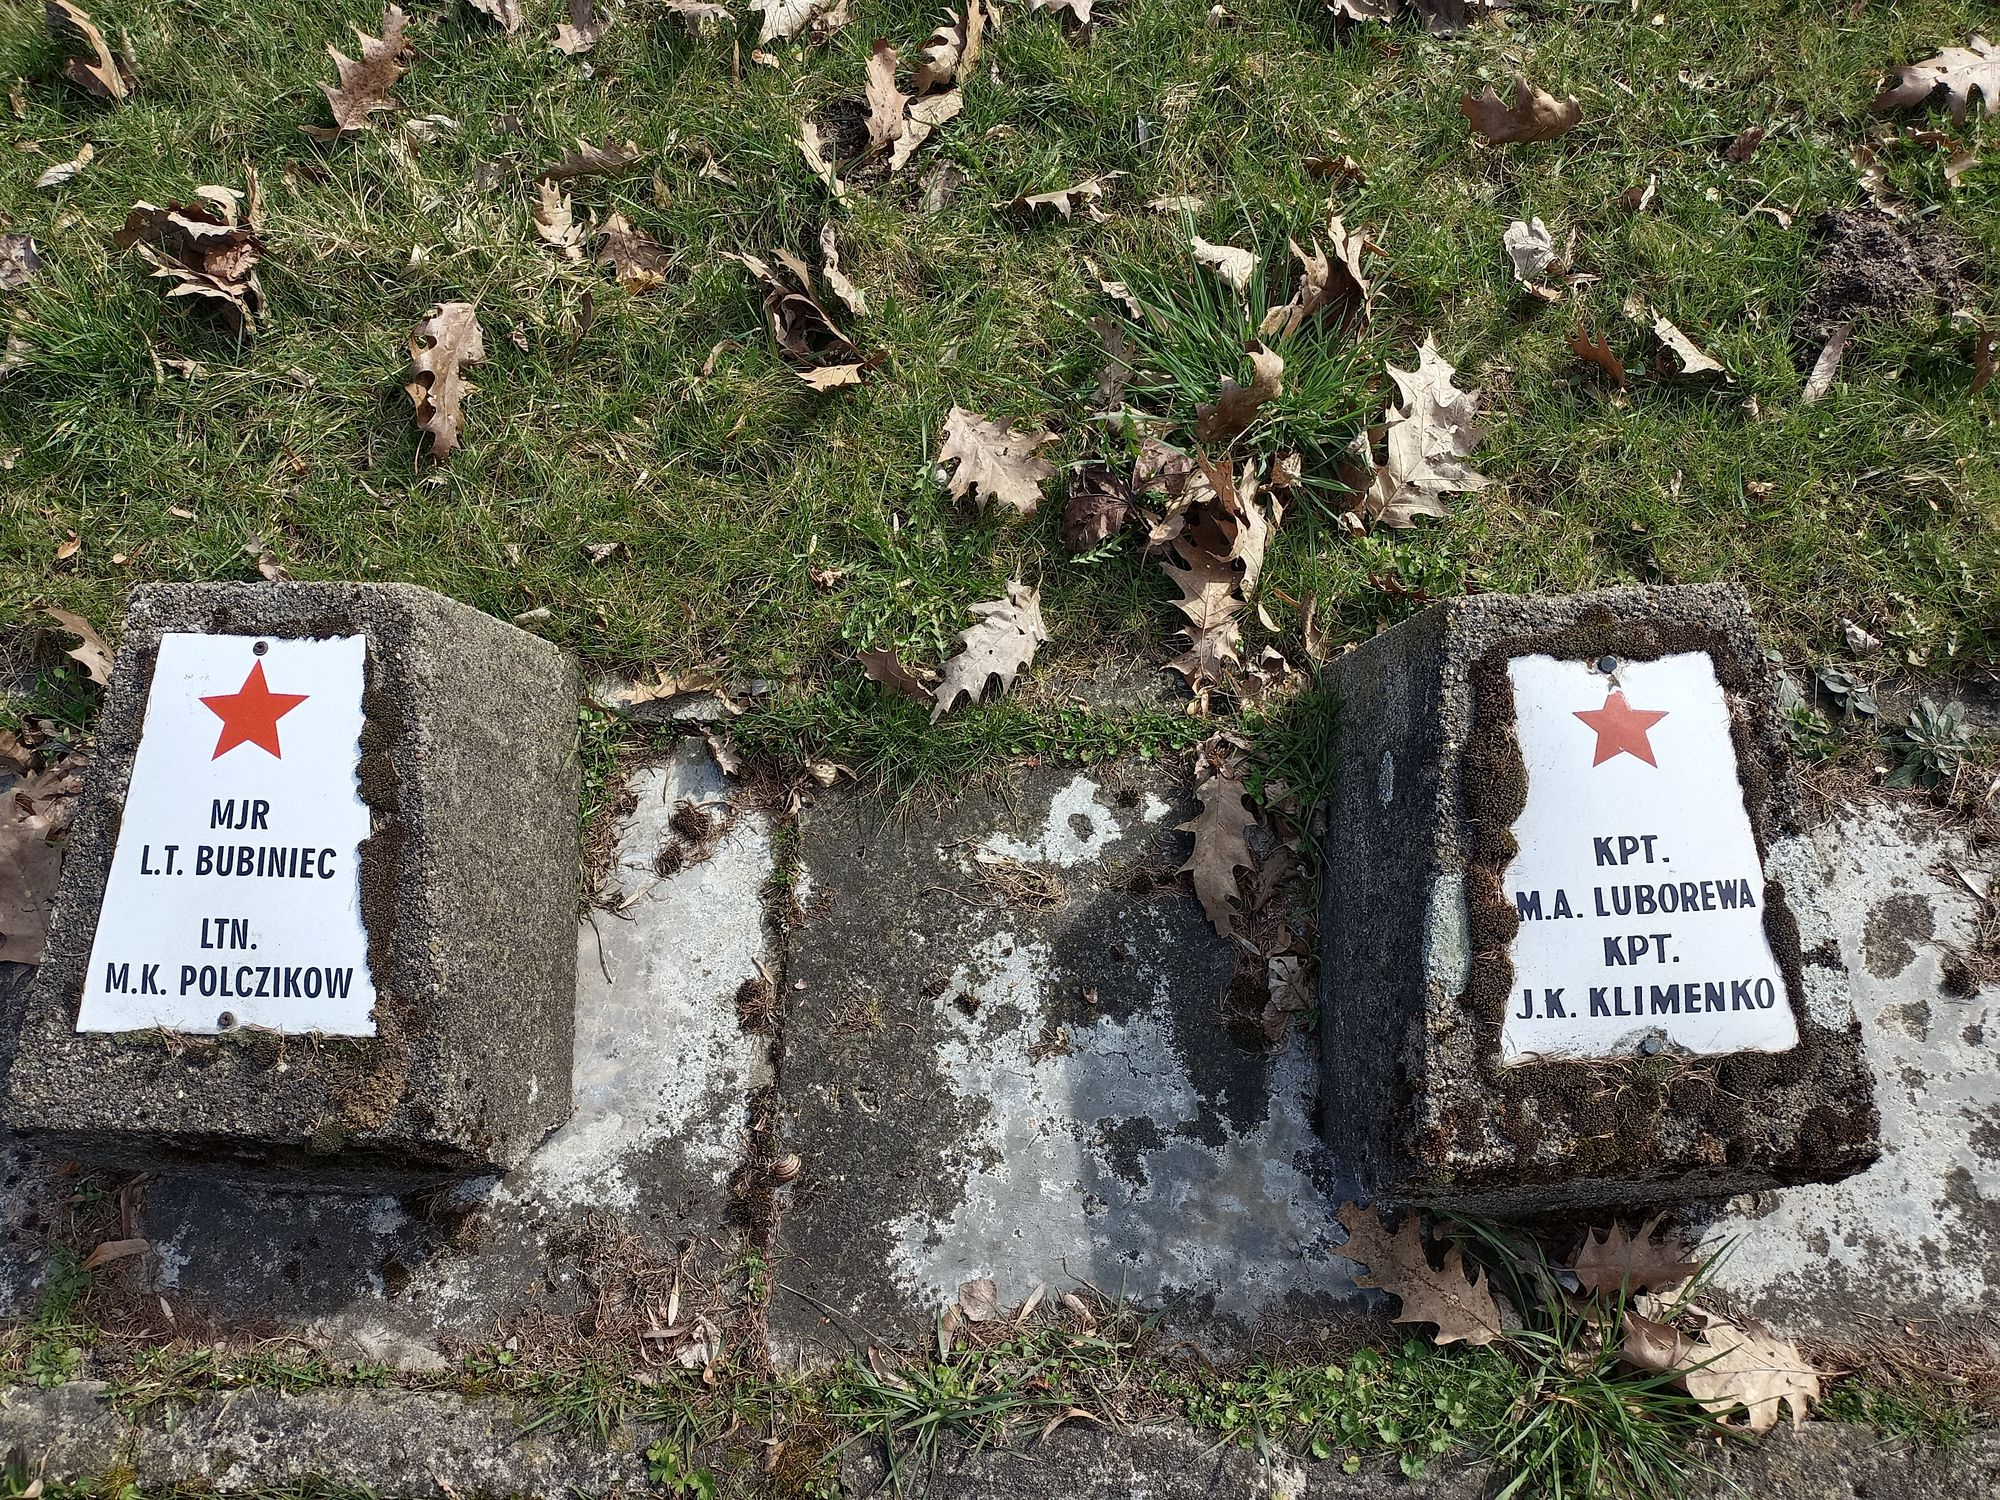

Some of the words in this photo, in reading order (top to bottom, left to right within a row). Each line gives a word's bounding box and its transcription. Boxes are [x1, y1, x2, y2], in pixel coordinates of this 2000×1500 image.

[210, 799, 270, 830] MJR
[140, 845, 183, 876] L.T.
[195, 846, 337, 880] BUBINIEC
[1593, 834, 1670, 866] KPT.
[1516, 889, 1584, 921] M.A.
[1593, 878, 1757, 917] LUBOREWA
[200, 917, 258, 951] LTN.
[1603, 933, 1680, 967] KPT.
[105, 962, 167, 996] M.K.
[179, 965, 354, 999] POLCZIKOW
[1515, 988, 1577, 1020] J.K.
[1589, 977, 1775, 1018] KLIMENKO
